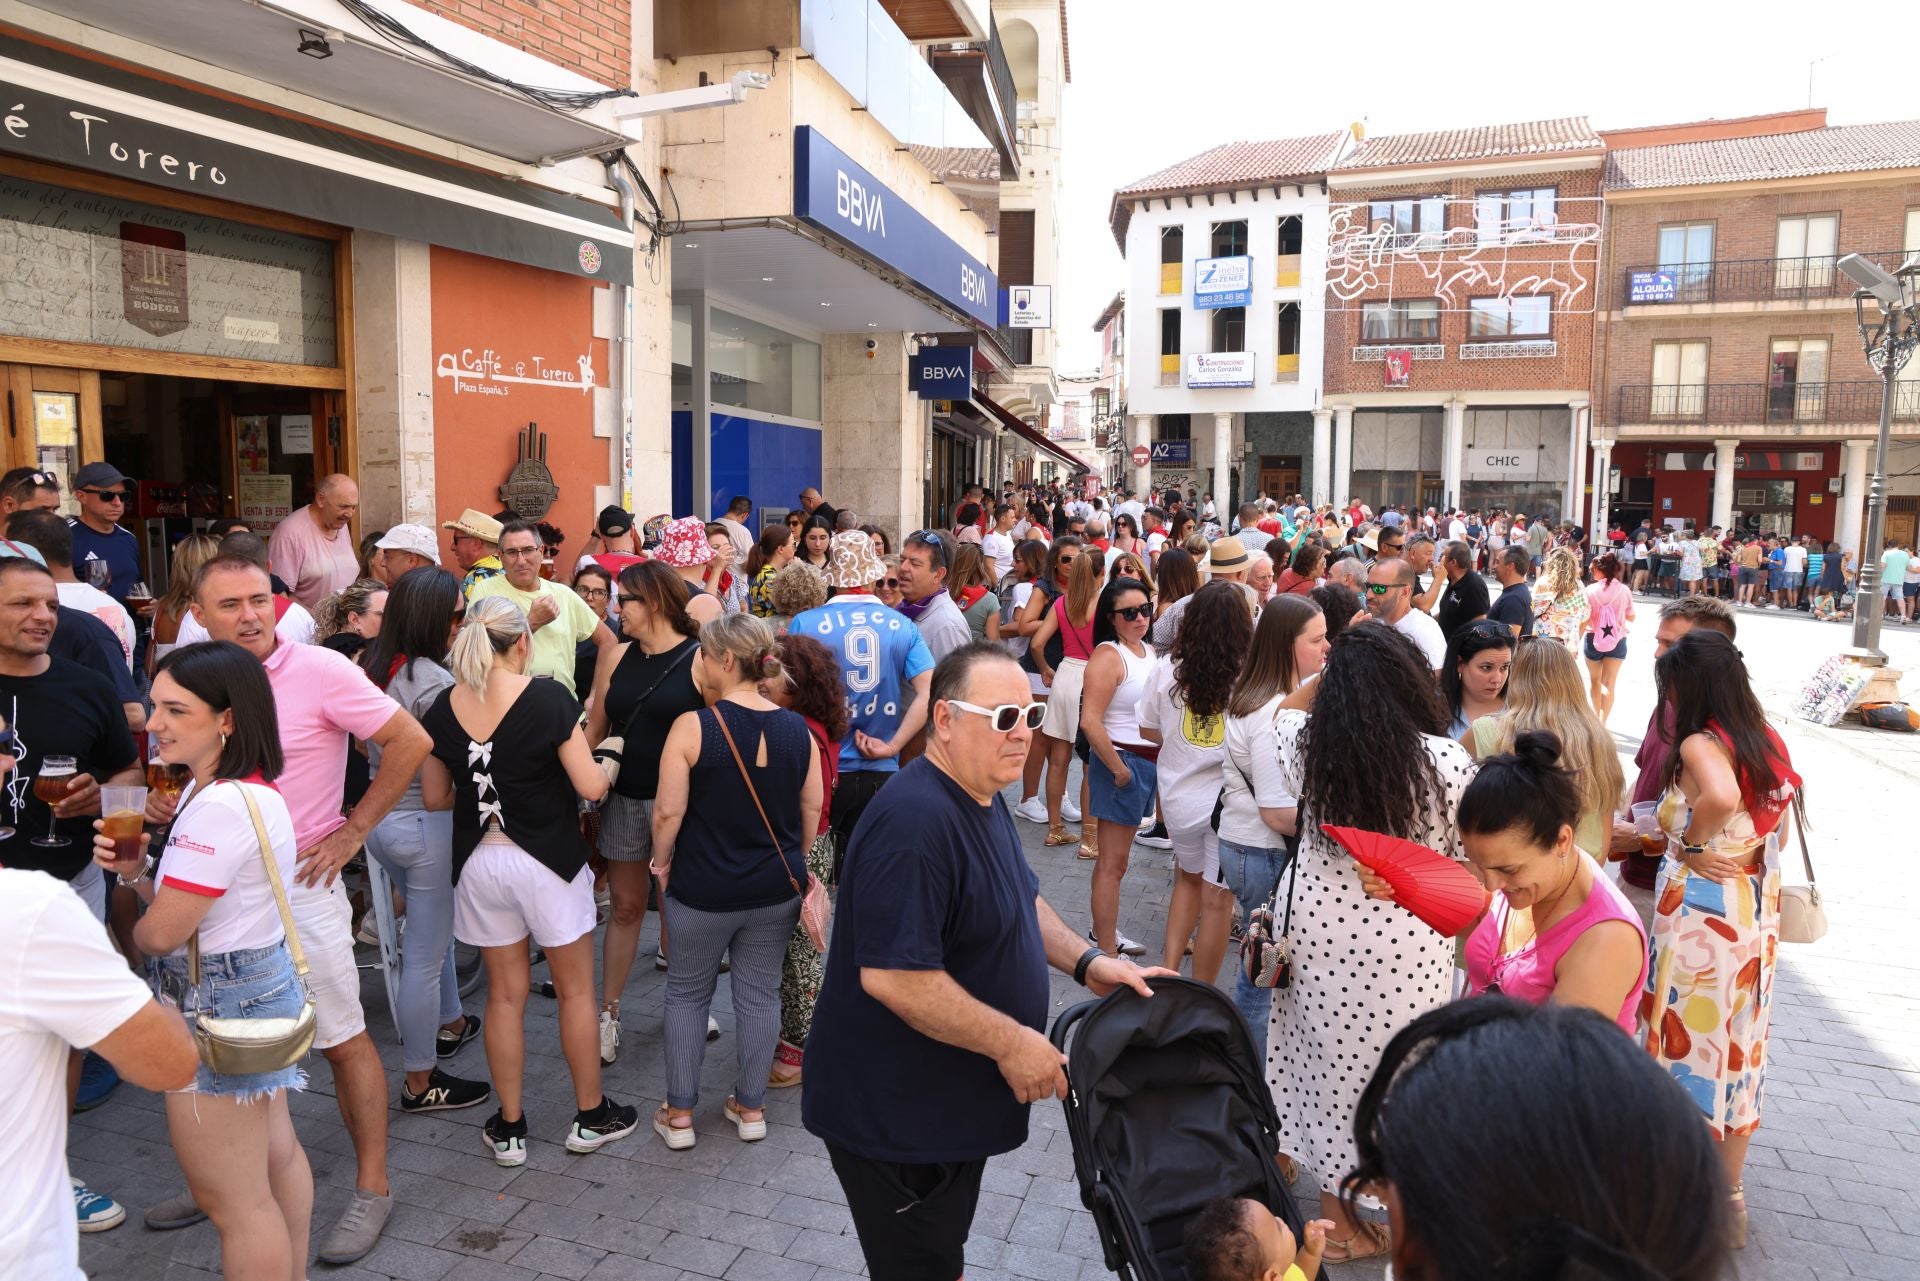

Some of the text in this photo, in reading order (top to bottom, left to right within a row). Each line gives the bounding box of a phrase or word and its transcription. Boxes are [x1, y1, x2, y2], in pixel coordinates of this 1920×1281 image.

[69, 111, 227, 185] Torero
[837, 168, 886, 238] BBVA
[960, 262, 987, 307] BBVA
[1632, 284, 1674, 294] ALQUILA
[133, 300, 180, 314] BODEGA
[462, 348, 575, 382] Caffé Torero
[923, 365, 966, 380] BBVA
[459, 382, 477, 393] Plaza
[504, 387, 509, 396] 5
[1152, 443, 1169, 458] A2
[1486, 455, 1520, 467] CHIC
[243, 506, 289, 517] VENTA EN ESTE
[817, 610, 901, 635] disco
[844, 625, 880, 693] 9
[421, 1087, 451, 1105] AX
